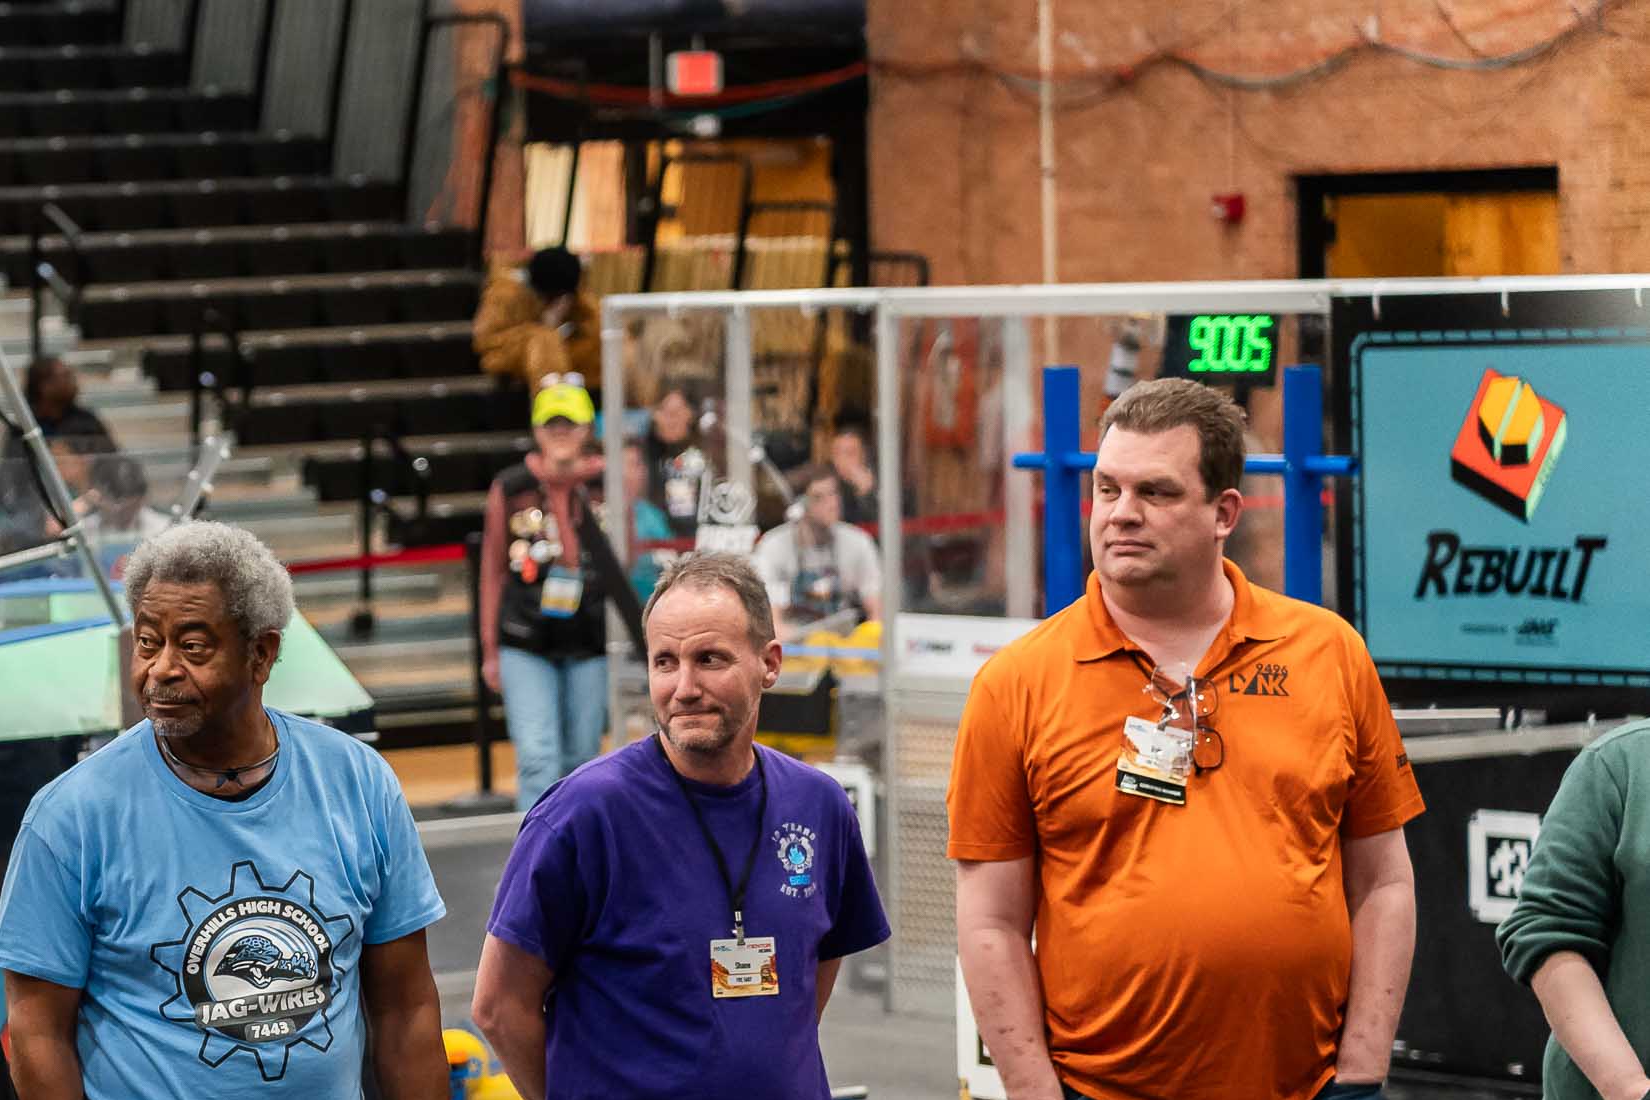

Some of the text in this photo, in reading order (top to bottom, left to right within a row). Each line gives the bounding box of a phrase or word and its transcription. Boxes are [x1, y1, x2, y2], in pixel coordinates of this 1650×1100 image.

[1188, 315, 1273, 372] 9005
[1414, 530, 1608, 604] REBUILT
[186, 900, 330, 975] OVERHILLS HIGH SCHOOL
[201, 984, 326, 1025] JAG-WIRES
[251, 1021, 290, 1039] 7443
